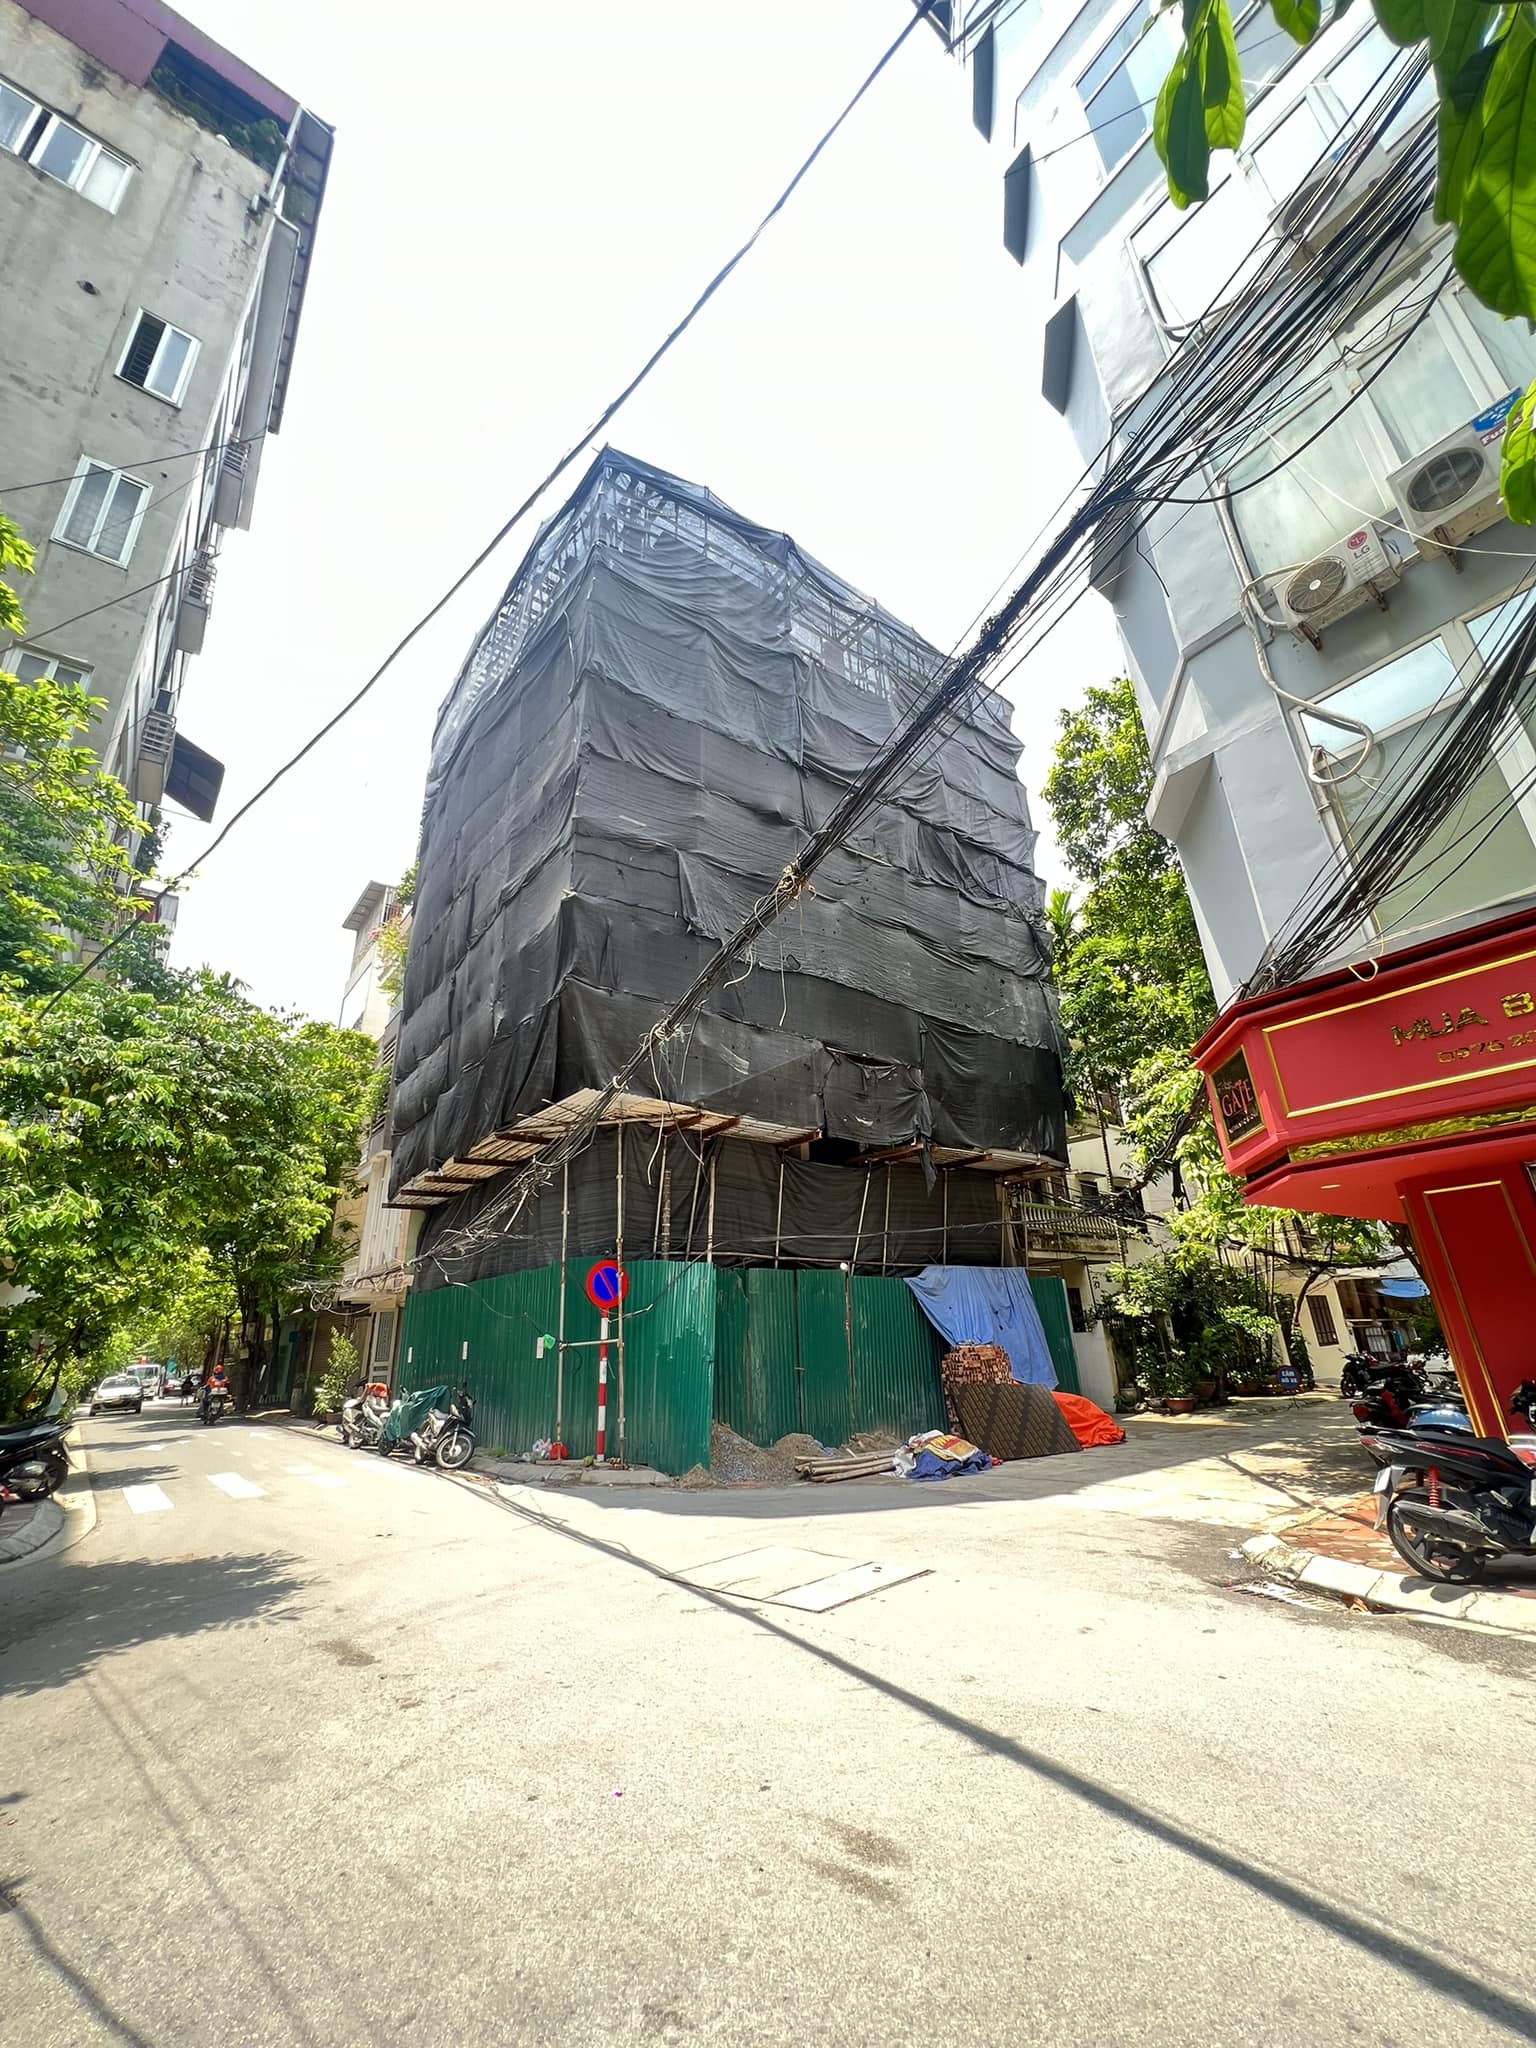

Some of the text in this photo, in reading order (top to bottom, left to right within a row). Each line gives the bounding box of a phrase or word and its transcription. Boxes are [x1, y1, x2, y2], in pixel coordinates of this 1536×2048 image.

[1353, 544, 1370, 559] LG
[1391, 1007, 1488, 1046] MUA
[1221, 1079, 1254, 1117] GATE
